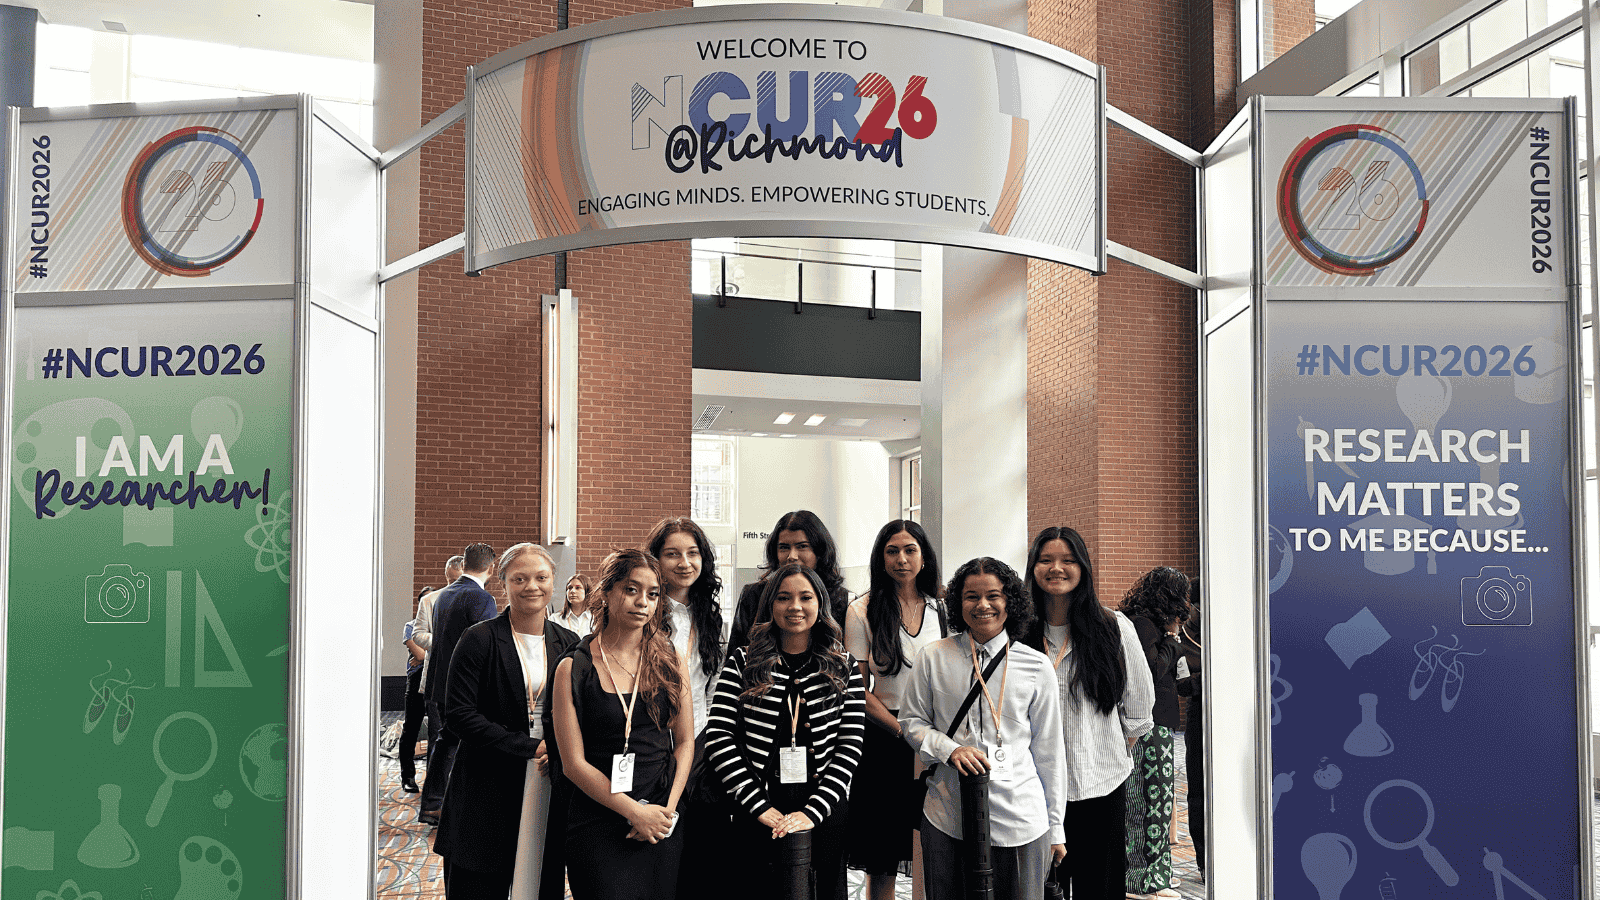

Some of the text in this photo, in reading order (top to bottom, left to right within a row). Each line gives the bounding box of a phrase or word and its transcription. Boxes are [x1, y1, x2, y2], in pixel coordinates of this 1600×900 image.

[697, 38, 867, 60] WELCOME TO
[665, 120, 904, 174] @Richmond
[30, 135, 51, 279] #NCUR2026
[578, 185, 991, 217] ENGAGING MINDS. EMPOWERING STUDENTS.
[1530, 126, 1552, 274] #NCUR2026
[42, 343, 266, 379] #NCUR2026
[1296, 344, 1537, 377] #NCUR2026
[76, 433, 235, 477] I AM A
[1304, 428, 1531, 464] RESEARCH
[34, 468, 271, 519] Researcher!
[1316, 481, 1522, 517] MATTERS
[743, 531, 770, 539] Fifth Str
[1289, 528, 1549, 553] TO ME BECAUSE...
